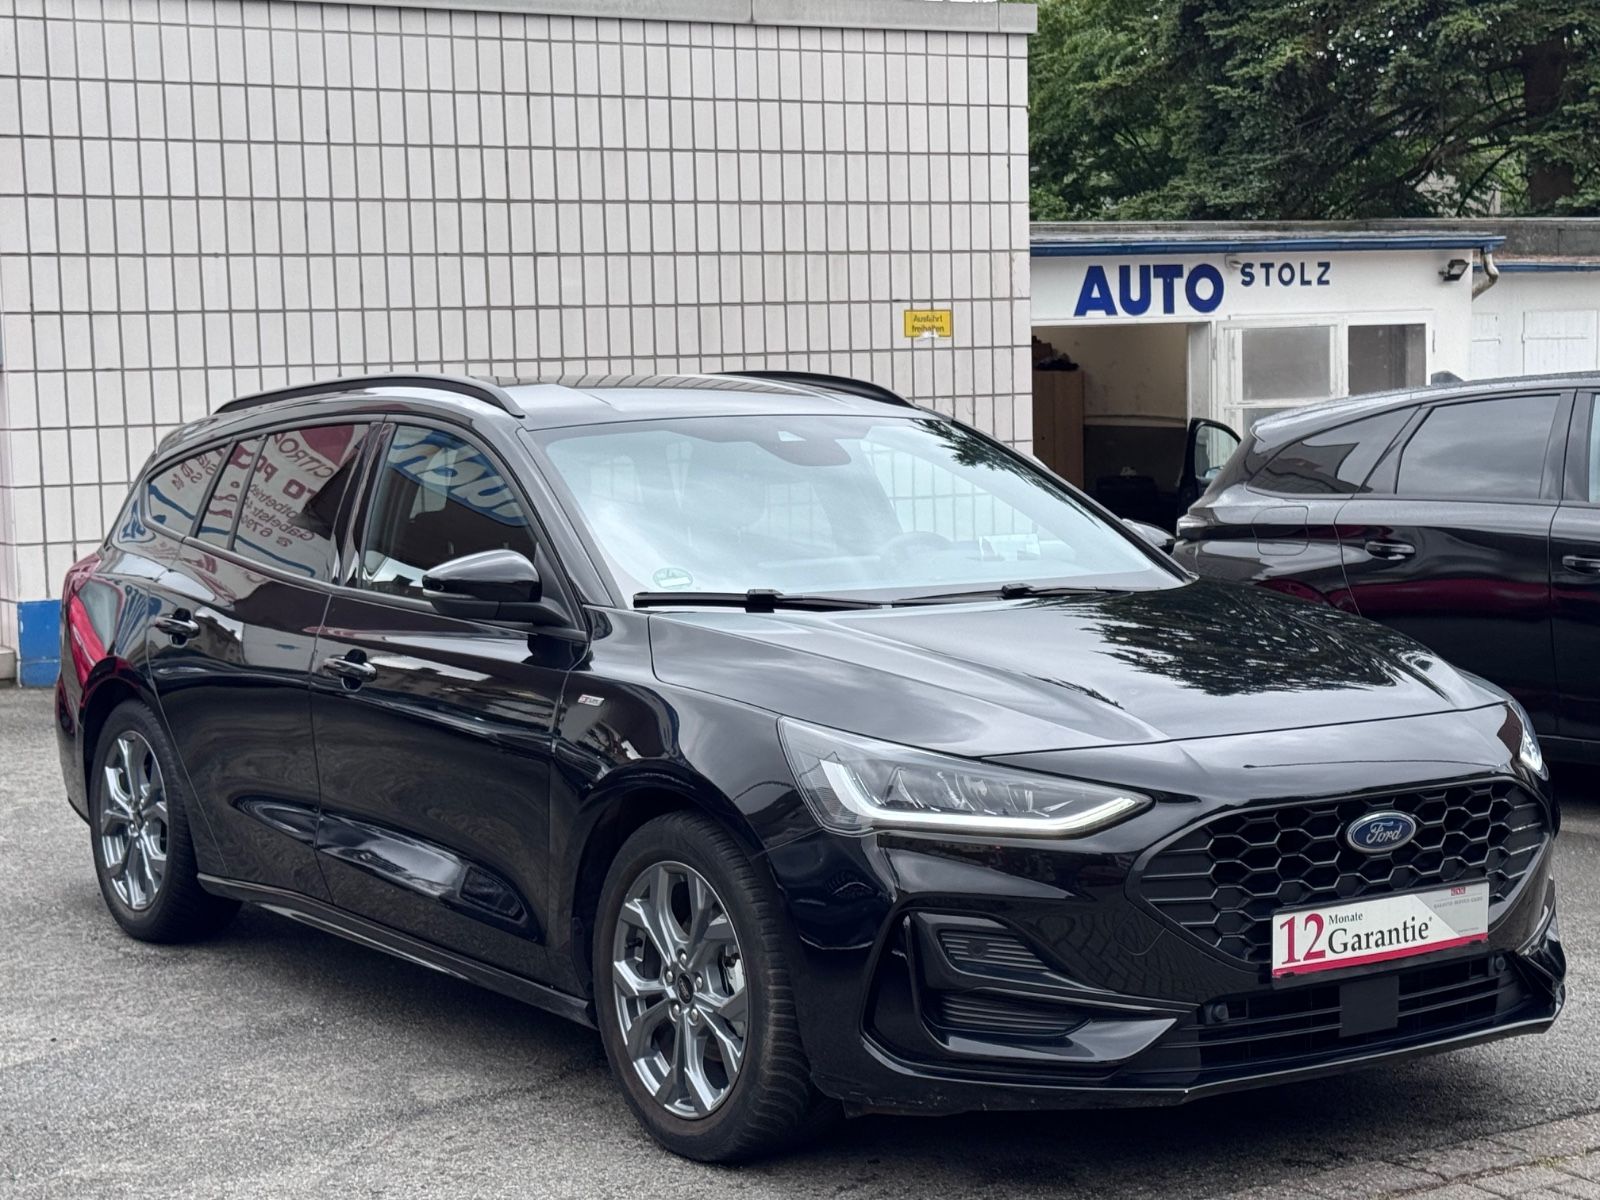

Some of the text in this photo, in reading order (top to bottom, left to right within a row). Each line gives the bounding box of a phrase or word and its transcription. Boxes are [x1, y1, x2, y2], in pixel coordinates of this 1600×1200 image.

[1073, 261, 1332, 317] AUTO STOLZ
[1366, 820, 1403, 844] Ford
[1328, 911, 1364, 925] Monate
[1279, 912, 1327, 965] 12
